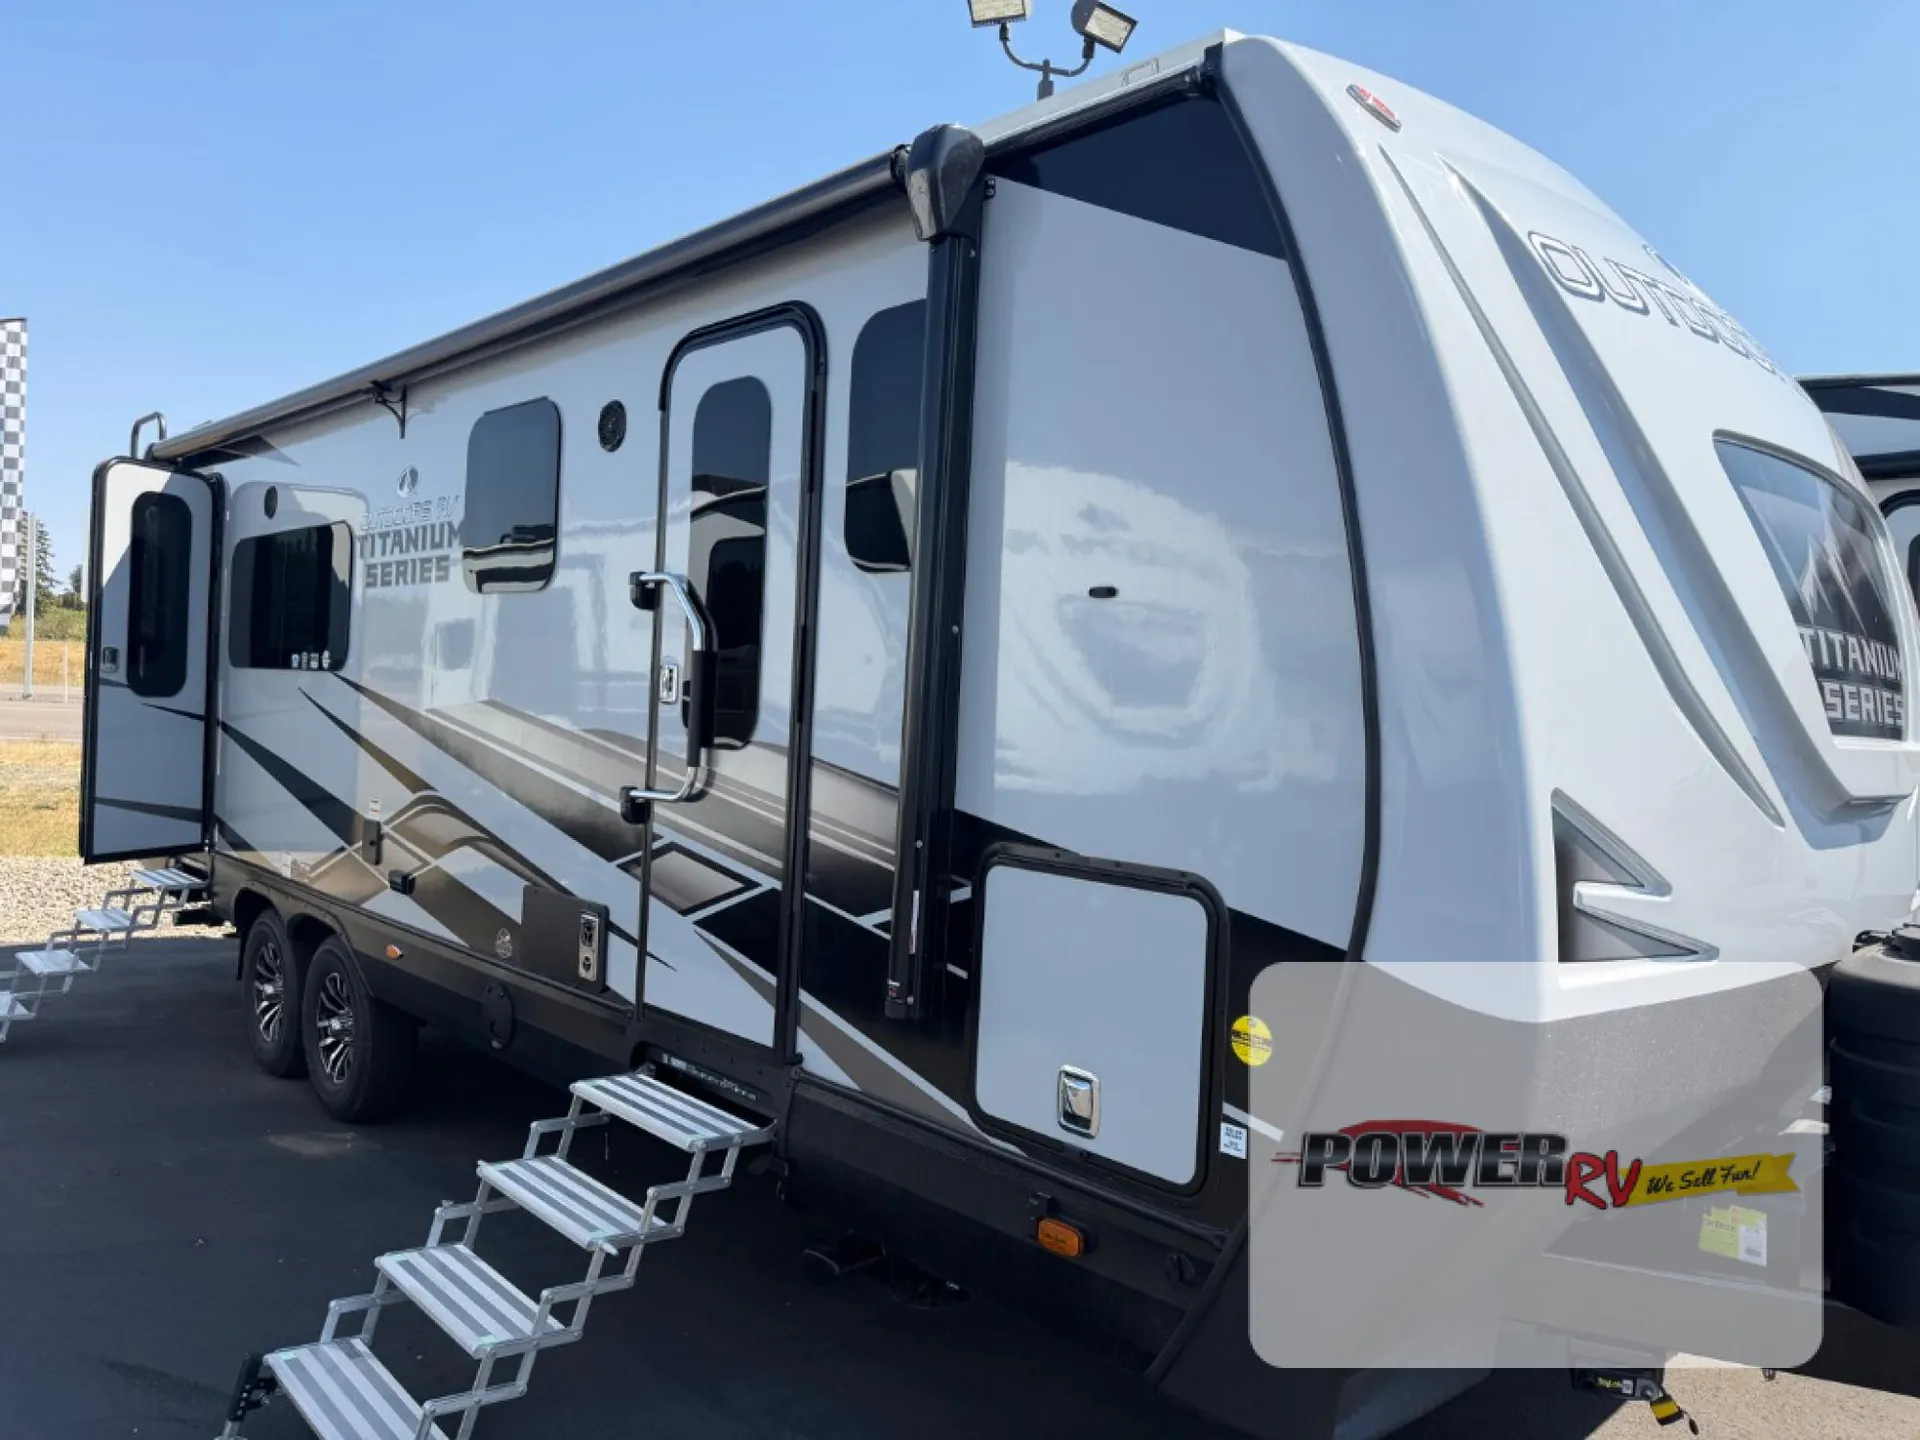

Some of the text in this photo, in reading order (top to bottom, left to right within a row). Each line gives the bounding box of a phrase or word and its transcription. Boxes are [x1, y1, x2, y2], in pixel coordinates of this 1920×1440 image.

[356, 520, 462, 559] TITANIUM
[365, 554, 449, 588] SERIES
[1821, 682, 1904, 726] SERIES
